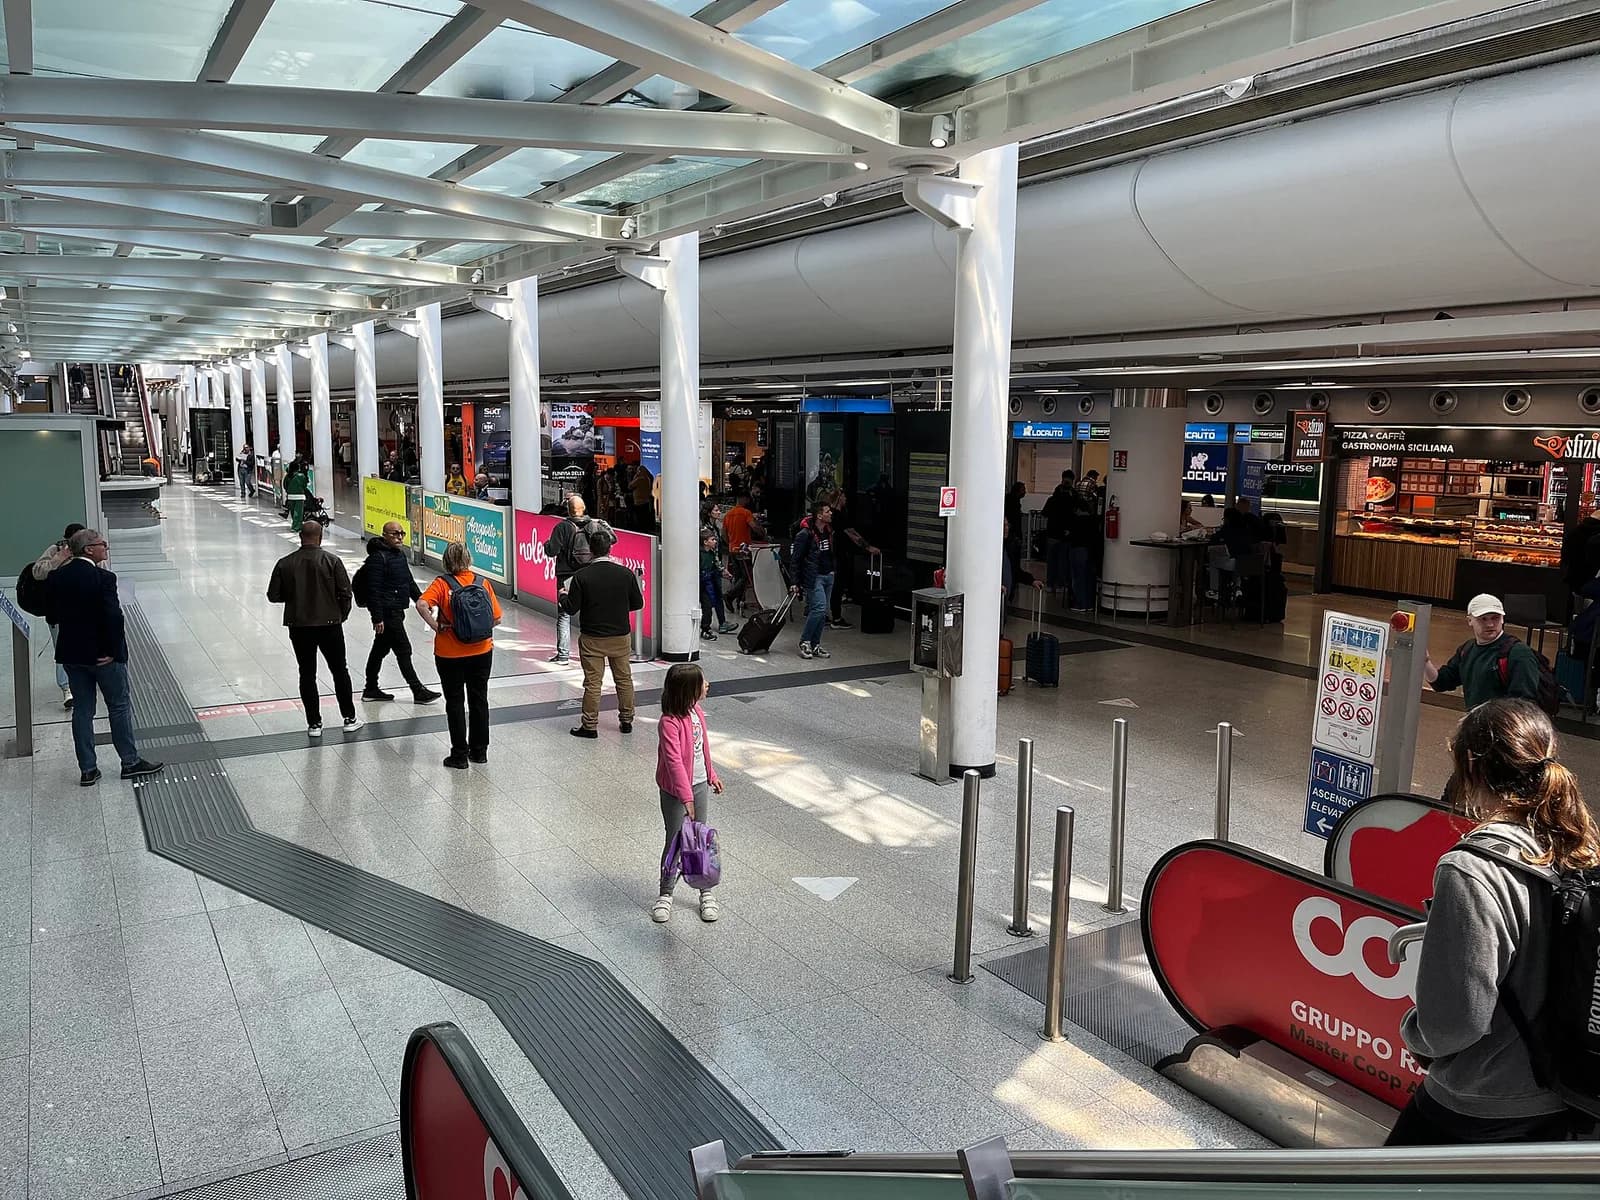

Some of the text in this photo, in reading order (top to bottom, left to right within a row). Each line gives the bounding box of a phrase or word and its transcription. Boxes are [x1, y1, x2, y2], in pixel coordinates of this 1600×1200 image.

[483, 407, 501, 415] SIXT
[552, 404, 570, 413] Etna
[552, 421, 566, 429] US!
[1032, 429, 1063, 437] LOCAUTO
[1342, 430, 1406, 441] PIZZA CAFFÈ
[1300, 439, 1317, 449] PIZZA
[1341, 442, 1455, 454] GASTRONOMIA SICILIANA
[1372, 455, 1398, 467] Pizze
[1312, 787, 1358, 808] ASCENSO
[1290, 1000, 1393, 1060] GRUPPO
[1290, 1024, 1349, 1062] Master
[1352, 1055, 1402, 1089] Coop
